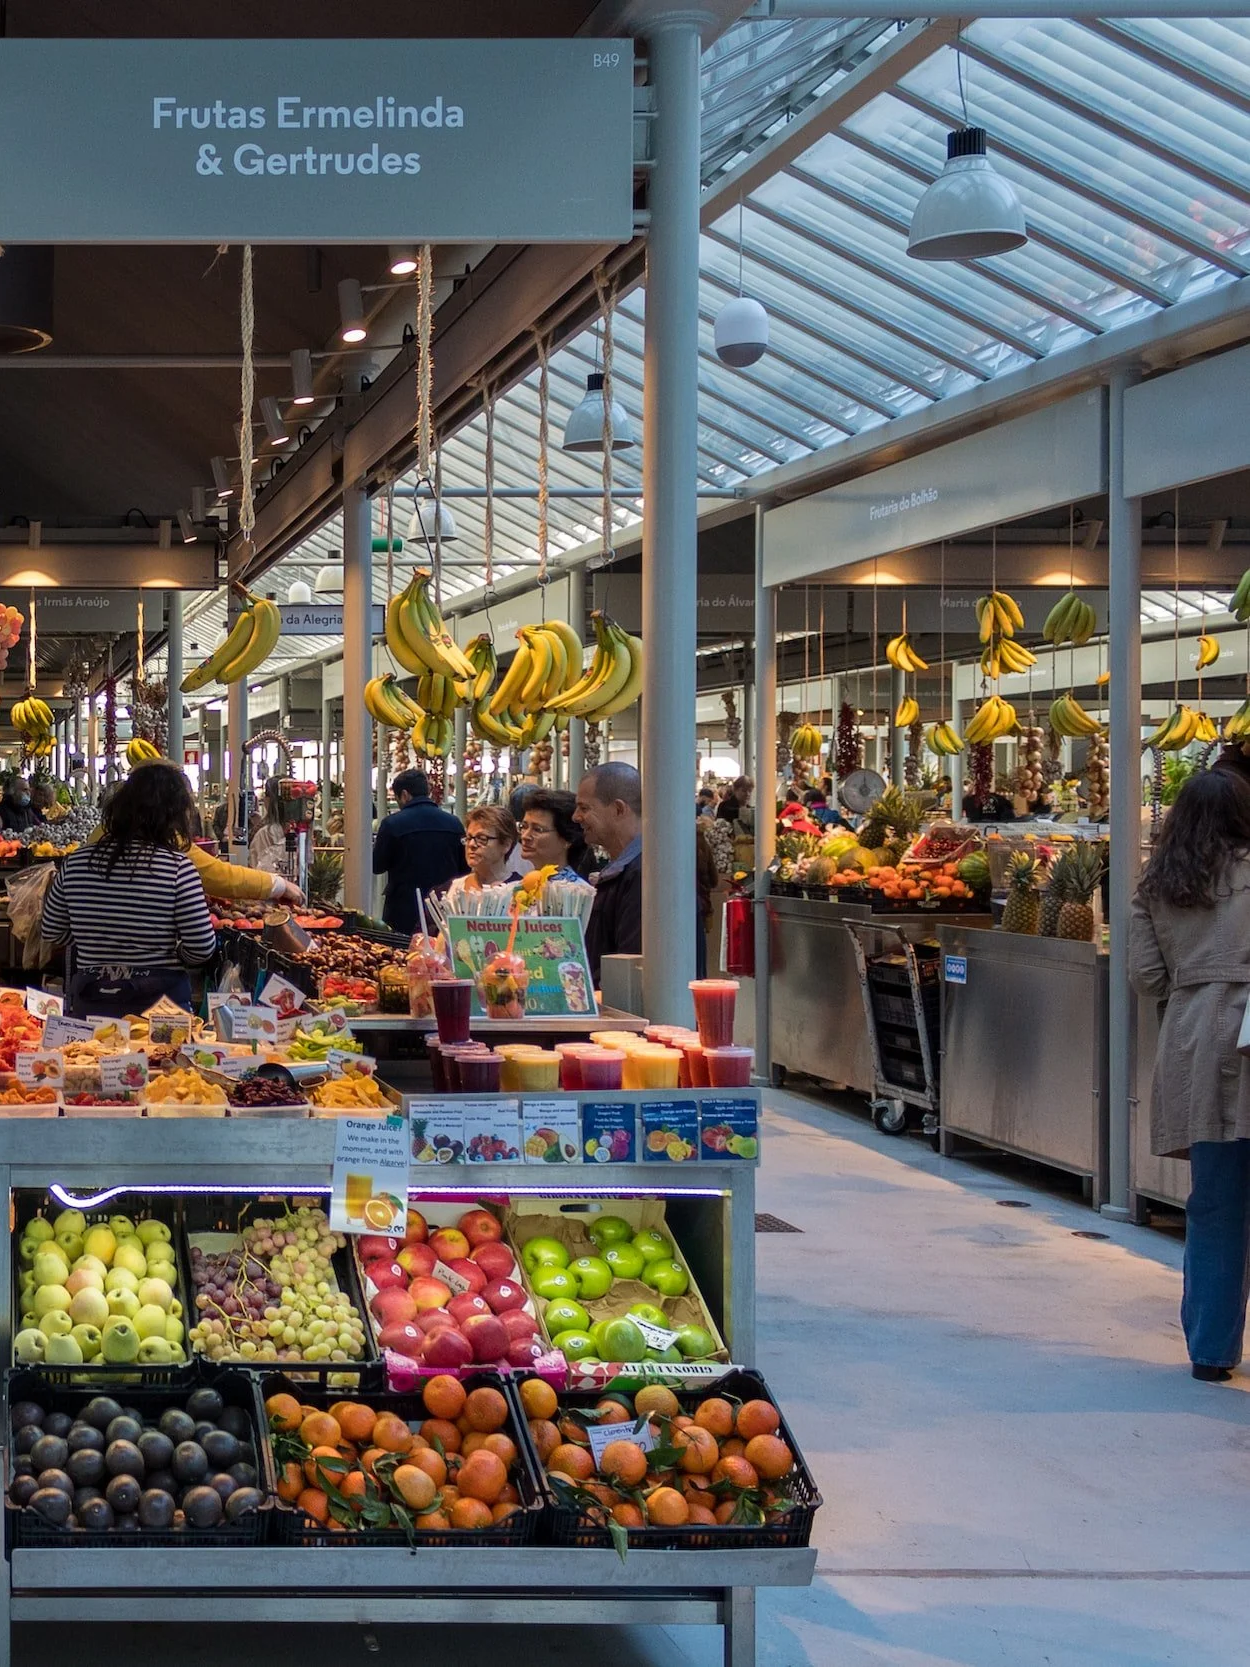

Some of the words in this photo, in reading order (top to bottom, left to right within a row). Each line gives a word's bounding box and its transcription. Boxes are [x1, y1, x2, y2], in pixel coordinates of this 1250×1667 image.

[593, 53, 620, 68] B49
[153, 97, 265, 129] Frutas
[278, 96, 464, 130] Ermelinda
[195, 143, 223, 176] &
[234, 142, 421, 176] Gertrudes
[869, 502, 897, 521] Frutaria
[899, 497, 910, 512] do
[911, 488, 938, 508] Bolhão
[44, 596, 73, 607] Irmãs
[75, 595, 110, 609] Araújo
[712, 597, 726, 607] do
[728, 594, 755, 607] Álvar
[940, 597, 969, 608] Maria
[286, 614, 299, 625] da
[303, 614, 343, 627] Alegria
[525, 920, 563, 934] Juices
[346, 1120, 376, 1131] Orange
[360, 1135, 379, 1143] make
[388, 1137, 399, 1145] the
[342, 1146, 372, 1154] moment,
[374, 1147, 387, 1155] and
[388, 1148, 404, 1156] with
[336, 1155, 360, 1165] orange
[361, 1156, 379, 1165] from
